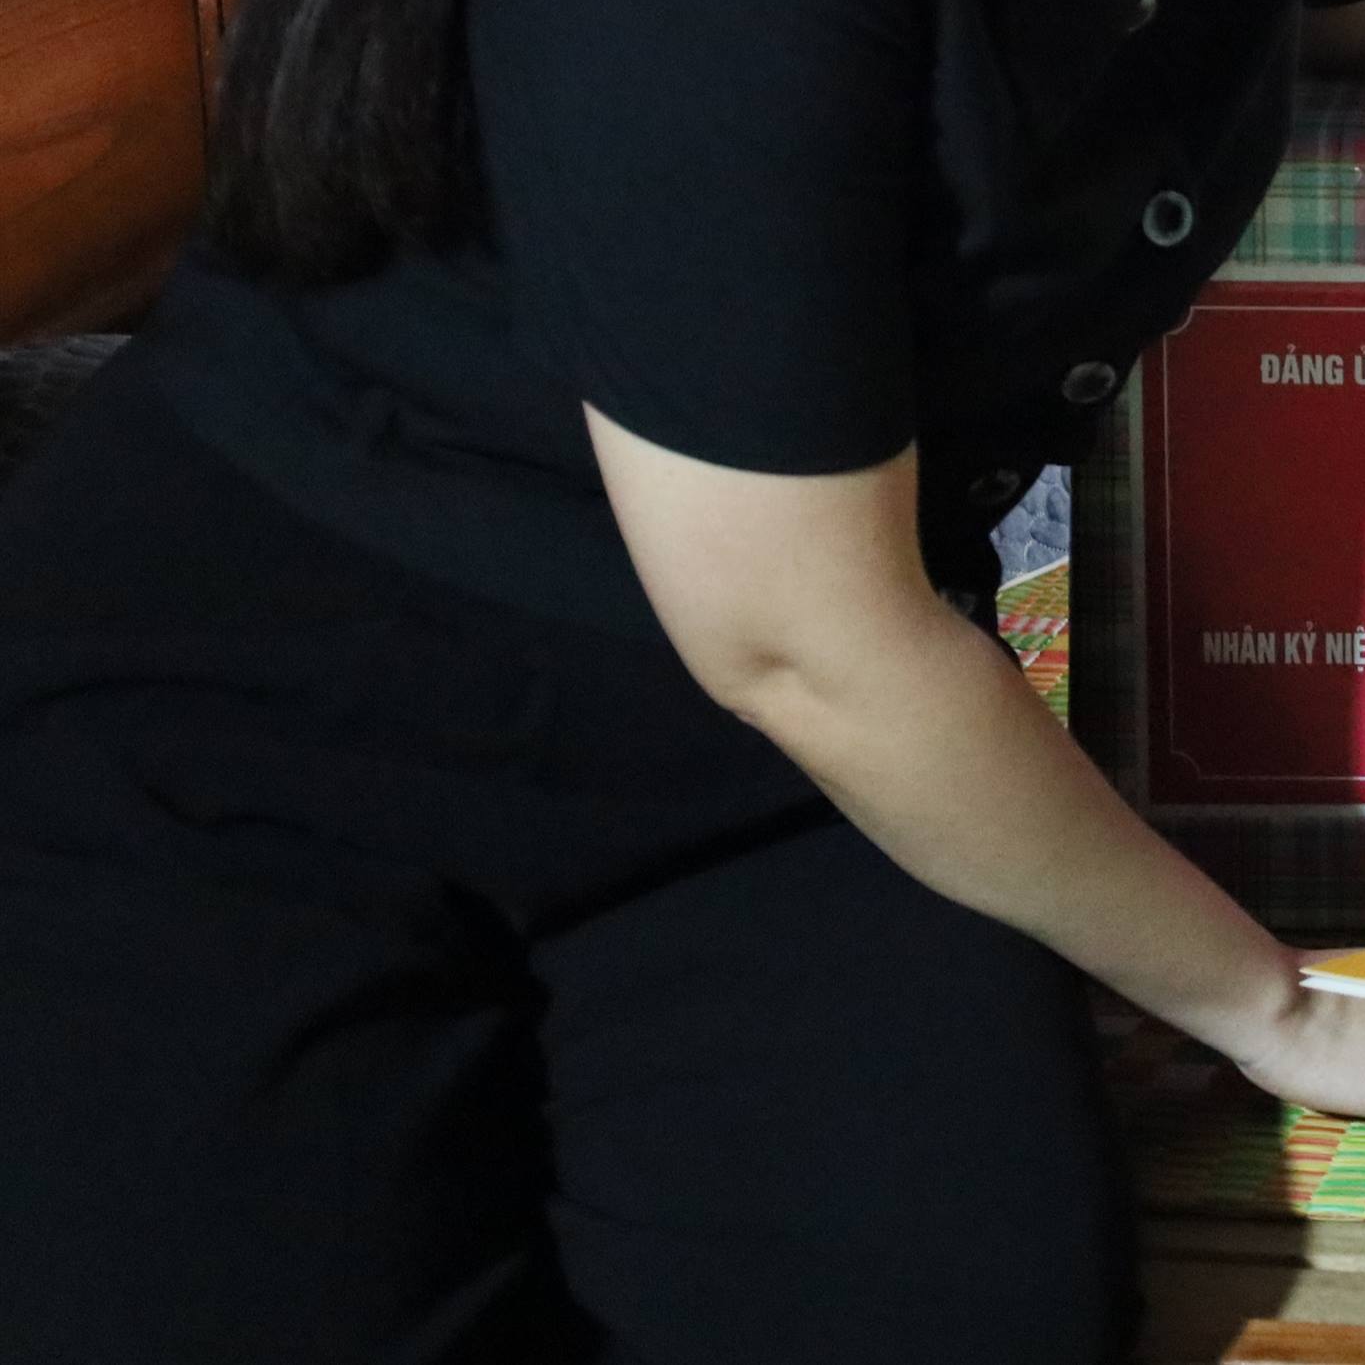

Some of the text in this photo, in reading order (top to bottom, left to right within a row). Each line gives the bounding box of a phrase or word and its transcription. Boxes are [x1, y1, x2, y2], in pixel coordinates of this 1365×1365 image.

[1261, 344, 1344, 386] ĐẢNG
[1204, 625, 1276, 664] NHÂN
[1284, 621, 1317, 664] KỶ
